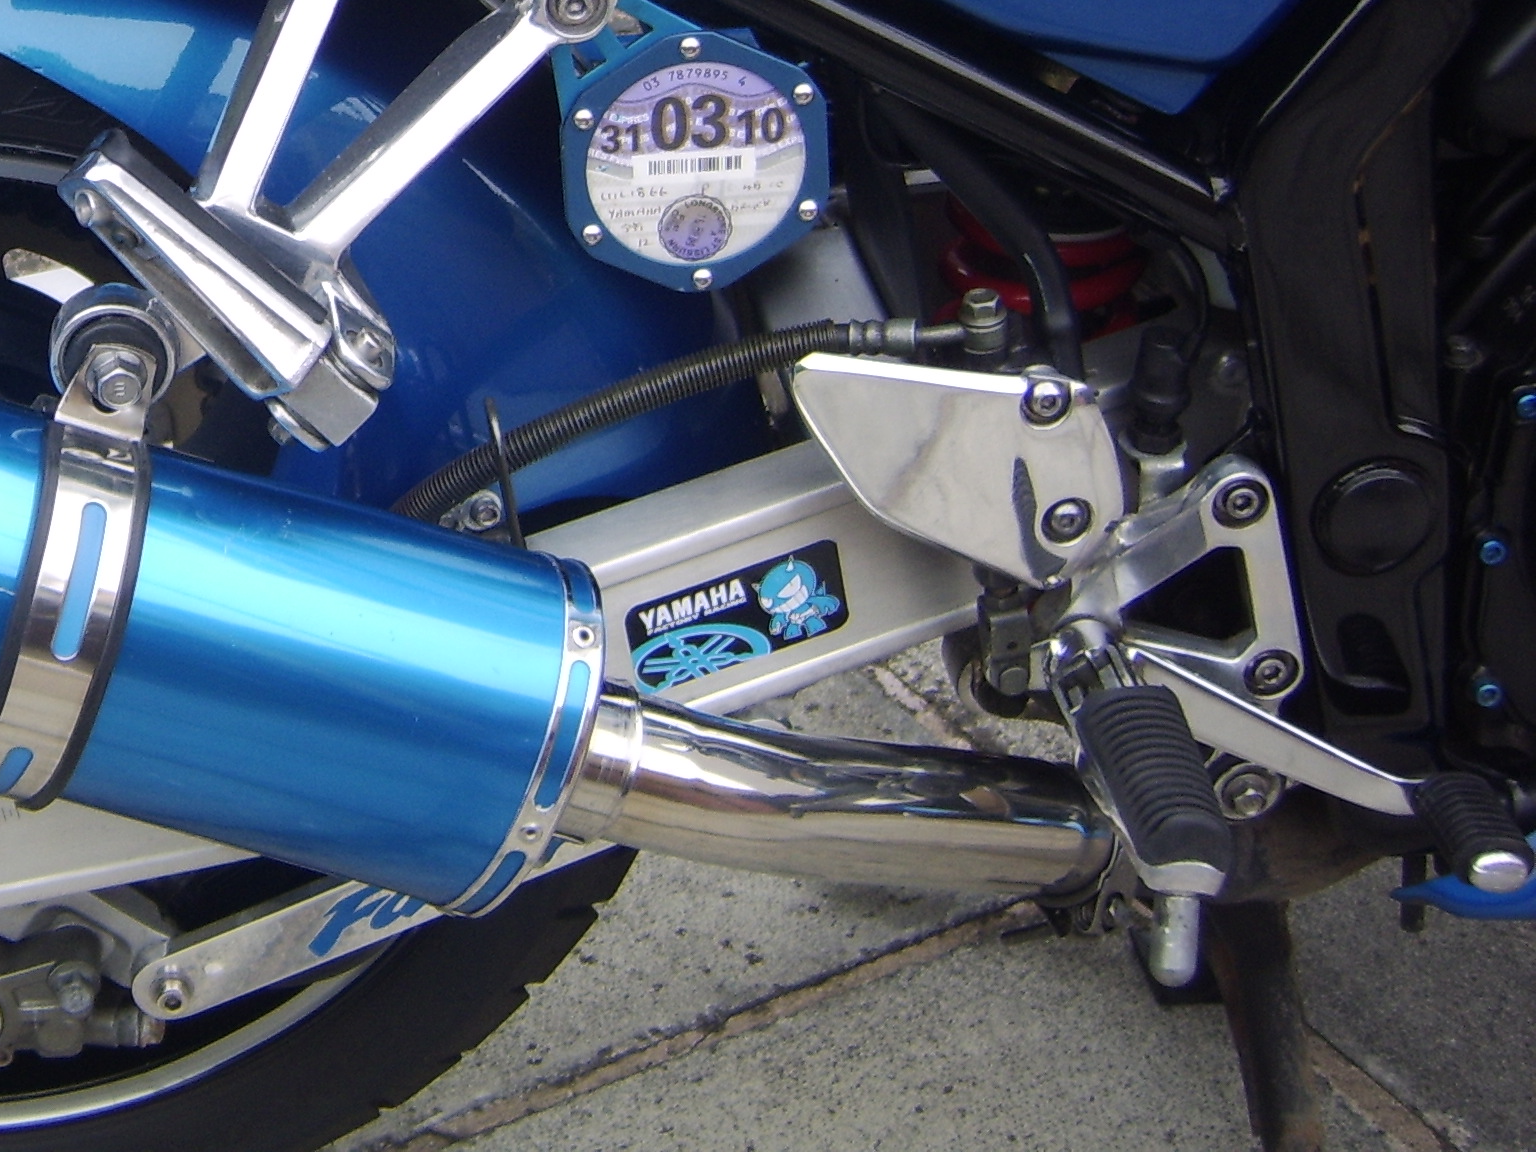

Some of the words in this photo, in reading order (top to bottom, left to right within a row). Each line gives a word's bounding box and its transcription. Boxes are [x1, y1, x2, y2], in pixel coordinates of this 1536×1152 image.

[643, 76, 661, 93] 03
[667, 67, 730, 83] 7879895
[599, 123, 648, 155] 31
[650, 93, 730, 152] 03
[737, 106, 786, 146] 10
[638, 578, 746, 629] YAMAHA
